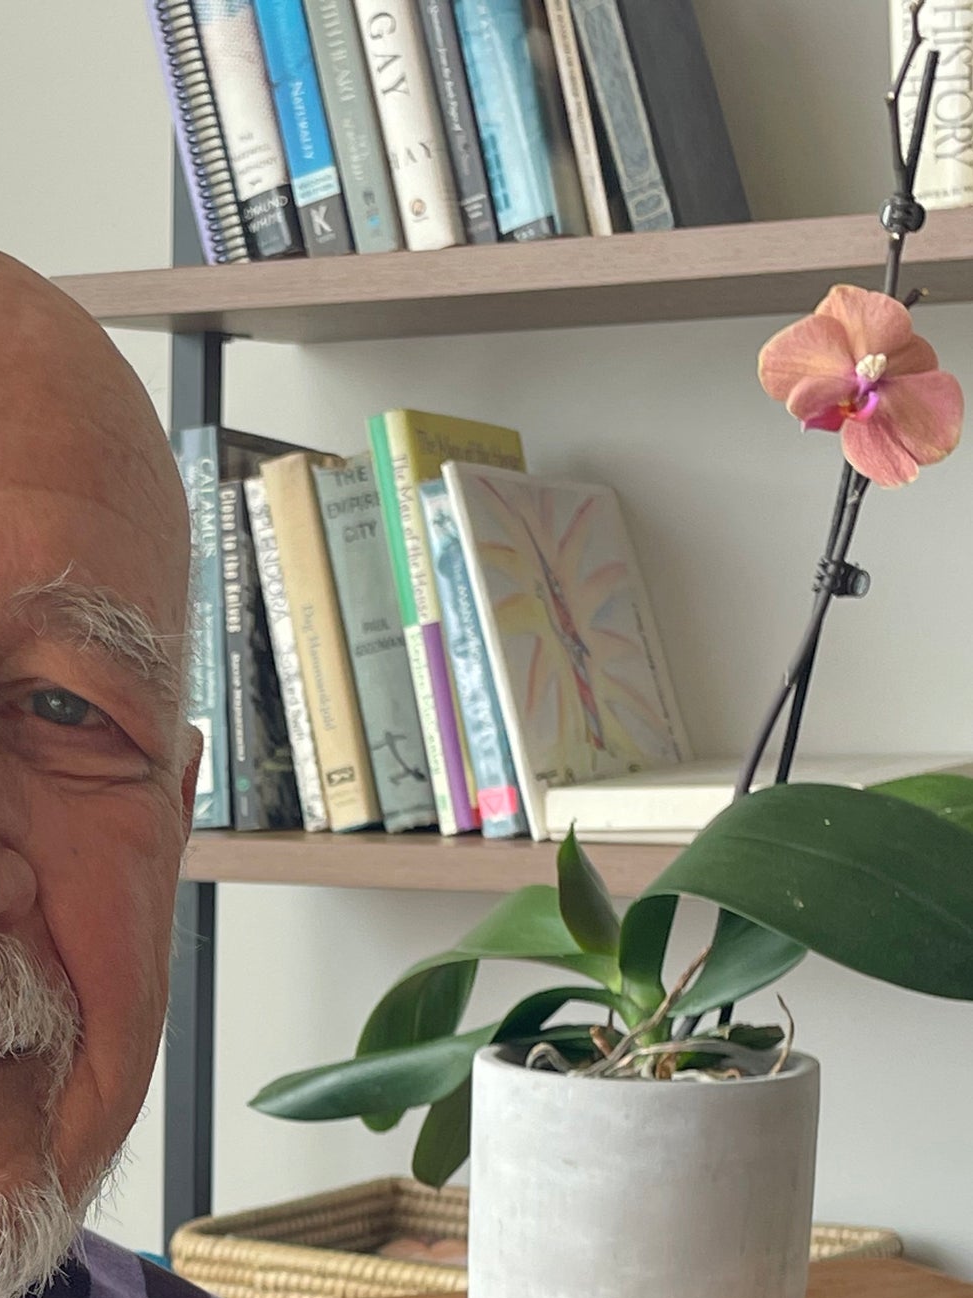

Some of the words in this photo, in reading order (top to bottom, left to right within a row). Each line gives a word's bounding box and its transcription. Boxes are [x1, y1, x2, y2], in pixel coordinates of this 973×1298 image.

[367, 11, 410, 97] GAY
[933, 5, 973, 166] HISTORY
[309, 205, 333, 236] K
[334, 465, 369, 488] THE
[392, 454, 407, 481] The
[200, 458, 217, 558] CALAMUS
[220, 489, 237, 532] Close
[399, 486, 414, 523] Man
[222, 535, 238, 552] to
[343, 520, 378, 544] CITY
[405, 526, 419, 546] of
[223, 555, 240, 581] the
[255, 502, 287, 622] SPLENDORA
[408, 544, 424, 570] the
[225, 584, 241, 634] Knives
[412, 568, 430, 620] House
